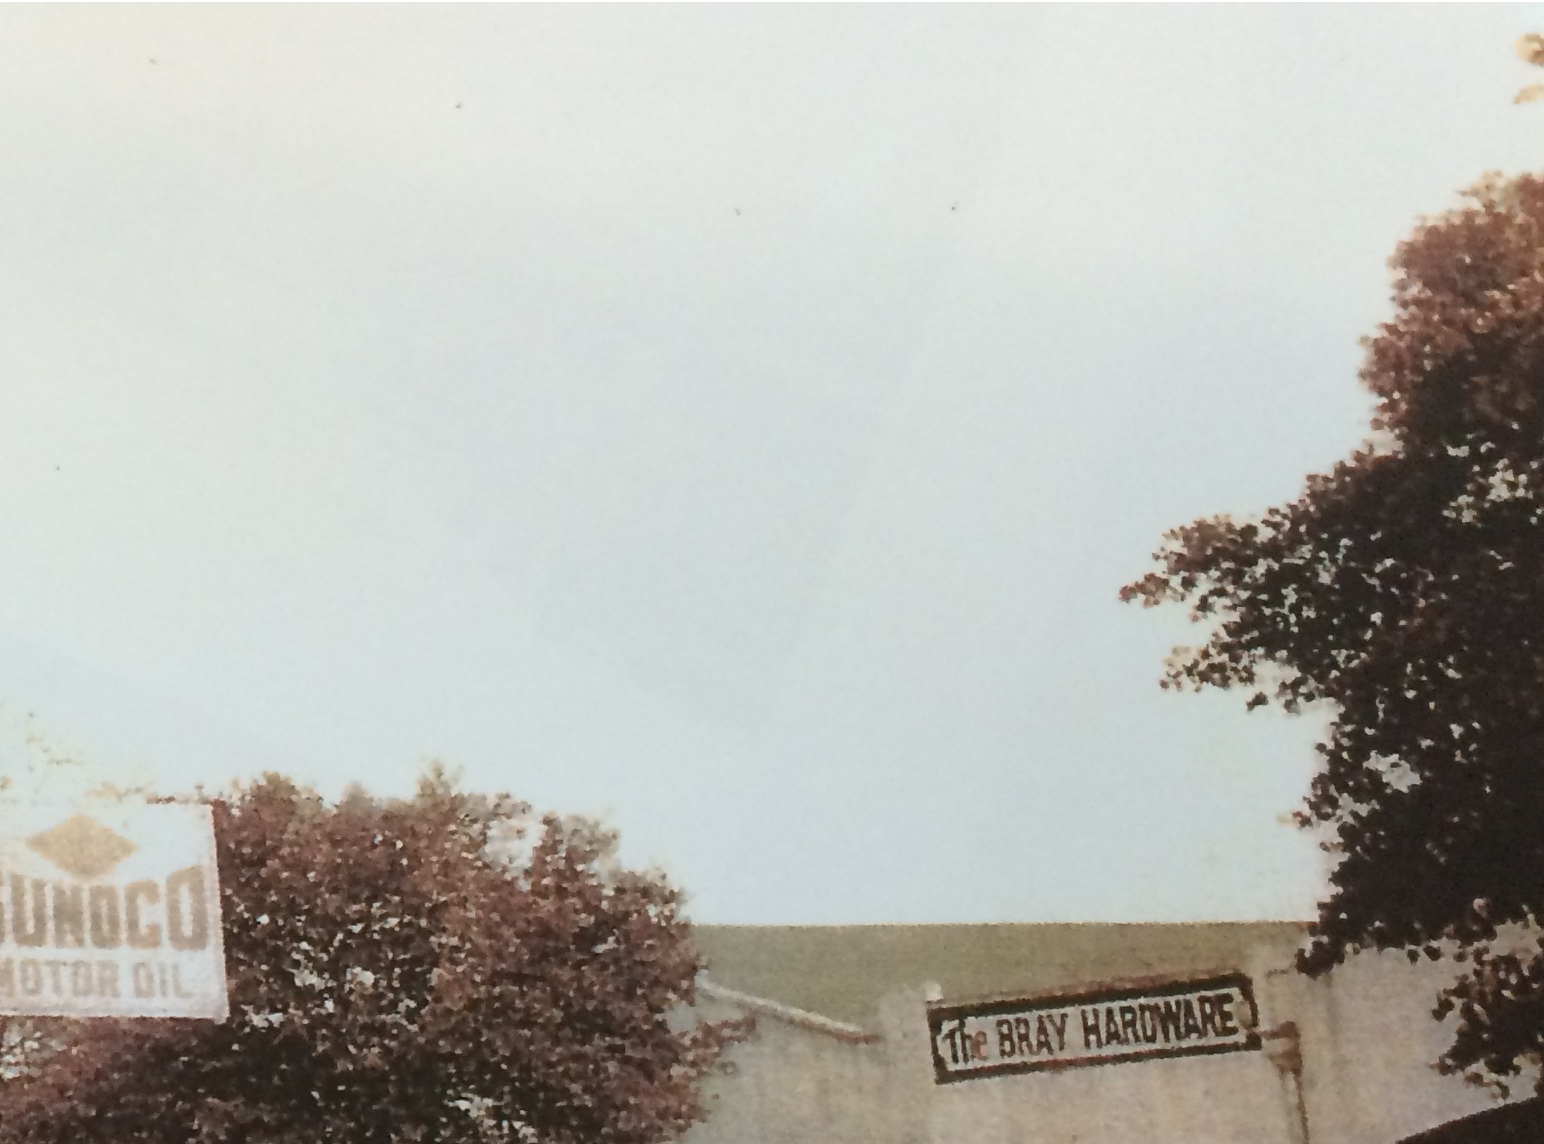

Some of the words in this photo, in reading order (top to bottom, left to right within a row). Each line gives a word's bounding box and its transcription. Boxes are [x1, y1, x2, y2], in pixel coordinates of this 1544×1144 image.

[131, 960, 196, 1001] OIL
[940, 1016, 988, 1065] The
[996, 1012, 1069, 1059] BRAY
[1080, 992, 1240, 1051] HARDWARE
